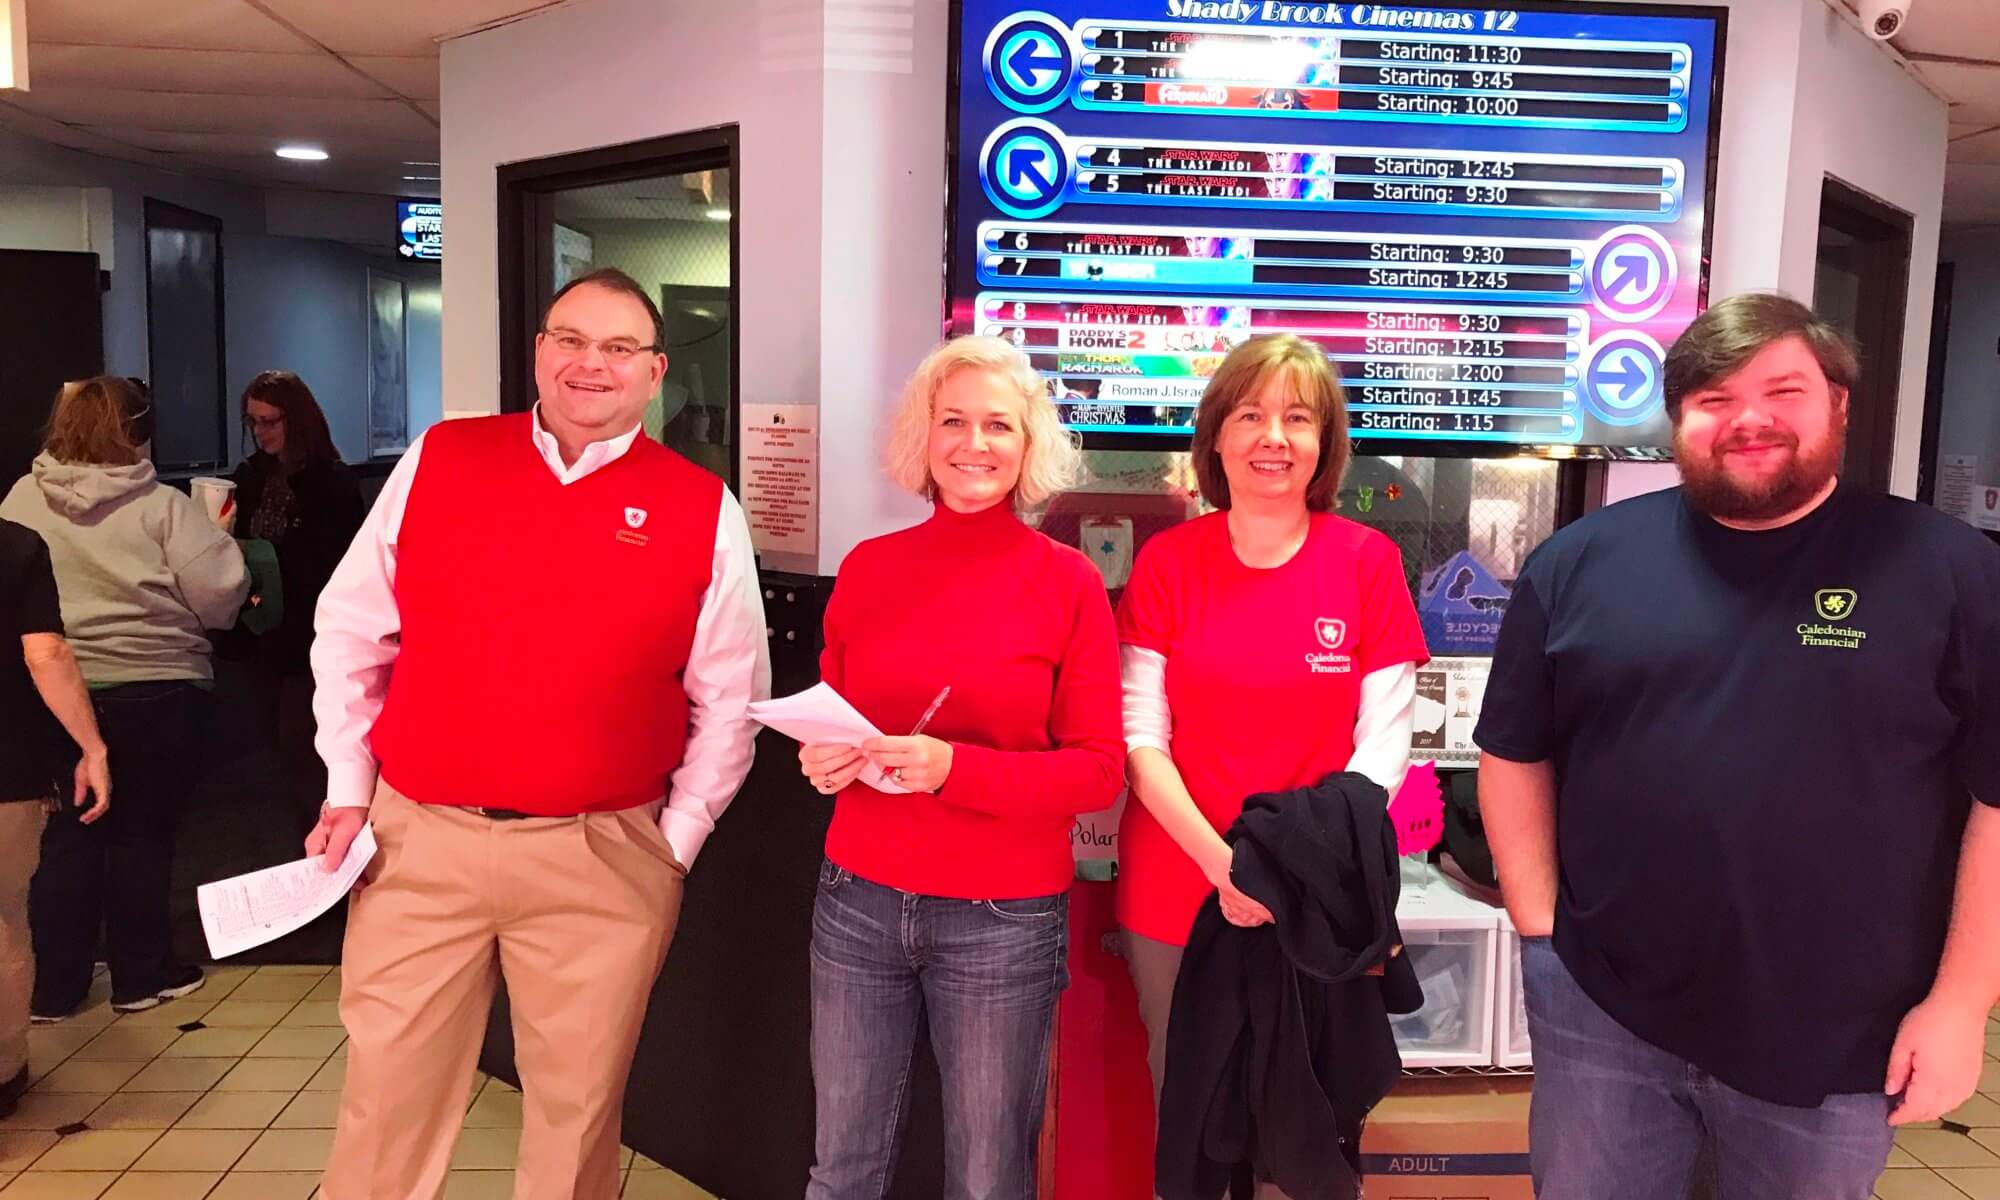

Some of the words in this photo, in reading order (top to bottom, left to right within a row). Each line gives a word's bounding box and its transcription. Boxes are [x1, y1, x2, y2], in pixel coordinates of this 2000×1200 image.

[1166, 0, 1259, 23] Shady
[1261, 1, 1345, 24] Brook
[1351, 4, 1474, 30] Cinemas
[1482, 9, 1519, 32] 12
[1114, 31, 1124, 48] 1
[1152, 41, 1176, 52] THE
[1380, 42, 1461, 63] Starting:
[1468, 46, 1521, 64] 11:30
[1112, 57, 1125, 75] 2
[1151, 67, 1175, 78] THE
[1379, 67, 1460, 89] Starting:
[1472, 71, 1513, 89] 9:45
[1111, 83, 1124, 101] 3
[1377, 93, 1458, 116] Starting:
[1465, 97, 1518, 115] 10:00
[1107, 149, 1120, 166] 4
[1147, 158, 1172, 168] THE
[1181, 160, 1212, 170] LAST
[1221, 161, 1251, 171] JEDI
[1374, 158, 1455, 178] Starting:
[1462, 161, 1514, 178] 12:45
[1107, 175, 1119, 193] 5
[1147, 184, 1171, 194] THE
[1180, 185, 1211, 195] LAST
[1220, 186, 1250, 197] JEDI
[1373, 183, 1453, 204] Starting:
[1466, 186, 1508, 203] 9:30
[1015, 233, 1028, 250] 6
[1067, 243, 1091, 253] THE
[1100, 244, 1131, 255] LAST
[1141, 245, 1170, 256] JEDI
[1370, 243, 1449, 263] Starting:
[1462, 246, 1504, 263] 9:30
[1015, 259, 1027, 276] 7
[1369, 268, 1448, 288] Starting:
[1455, 271, 1508, 288] 12:45
[1013, 302, 1026, 320] 8
[1064, 312, 1089, 323] THE
[1097, 313, 1128, 324] LAST
[1138, 315, 1167, 325] JEDI
[1366, 312, 1446, 332] Starting:
[1459, 315, 1500, 332] 9:30
[1013, 328, 1026, 346] 9
[1069, 337, 1126, 348] HOME
[1127, 330, 1146, 348] 2
[1365, 337, 1444, 357] Starting:
[1452, 340, 1504, 357] 12:15
[1086, 354, 1121, 363] THOR
[1061, 364, 1143, 375] RAGNAROK
[1363, 363, 1443, 382] Starting:
[1450, 365, 1504, 382] 12:00
[1112, 384, 1158, 397] Roman
[1362, 387, 1442, 407] Starting:
[1450, 389, 1501, 407] 11:45
[1070, 411, 1126, 425] CHRISTMAS
[1361, 412, 1440, 432] Starting:
[1454, 415, 1494, 431] 1:15
[1796, 623, 1867, 639] Caledonian
[1801, 634, 1859, 649] Financial
[1070, 820, 1120, 847] Polar
[1389, 1156, 1450, 1173] ADULT
